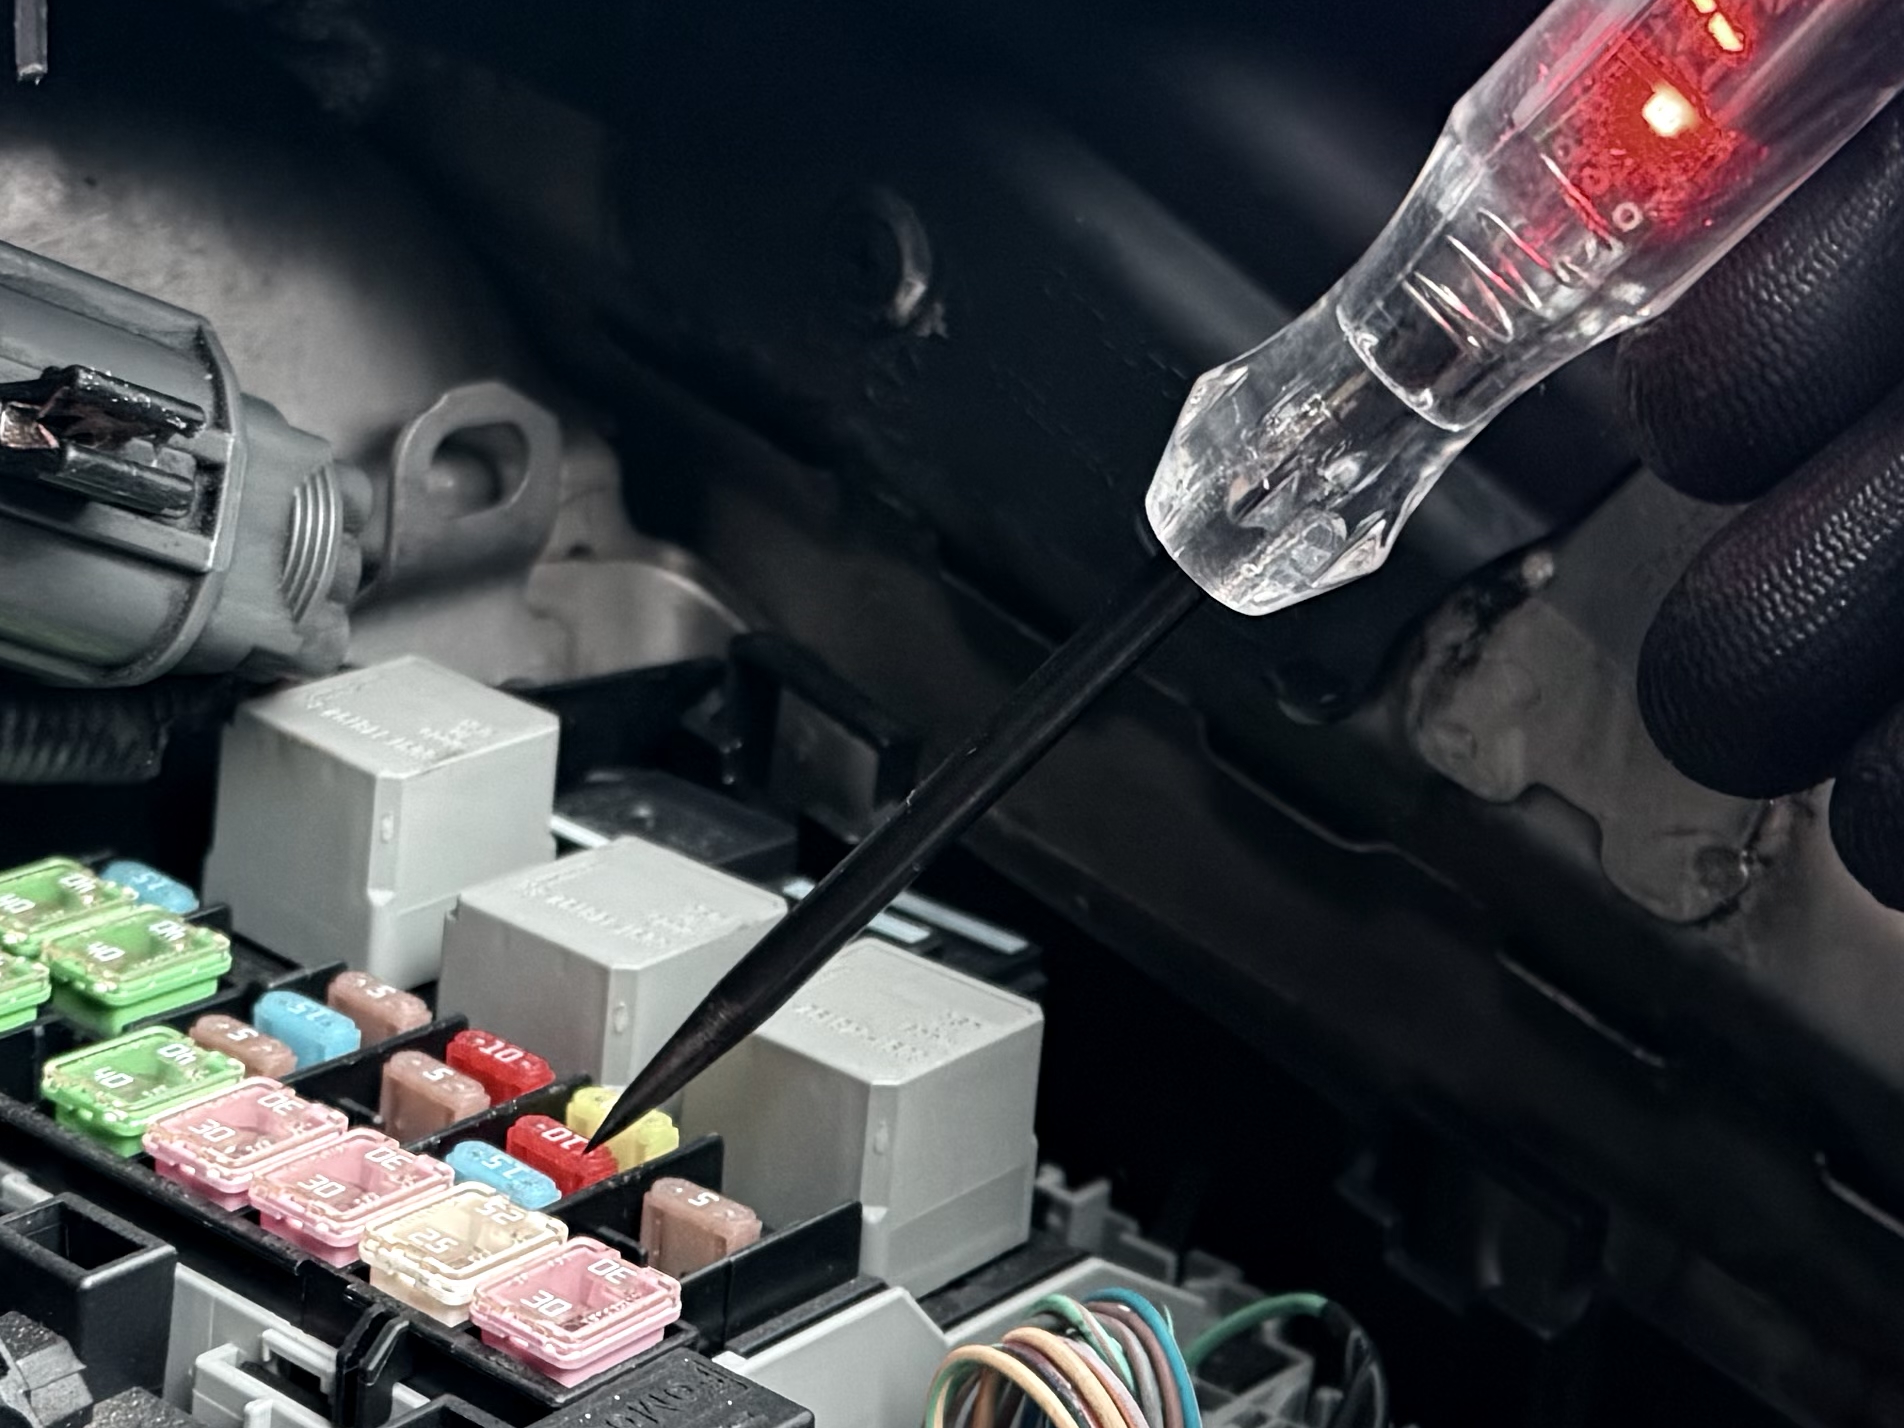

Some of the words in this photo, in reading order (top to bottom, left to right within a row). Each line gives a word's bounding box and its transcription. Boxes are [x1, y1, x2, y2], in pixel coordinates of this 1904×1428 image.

[85, 941, 125, 963] 40
[156, 1042, 198, 1065] 40
[478, 1039, 525, 1063] 10
[93, 1066, 134, 1090] 40
[422, 1066, 455, 1082] 5
[256, 1091, 306, 1116] 30
[187, 1118, 236, 1144] 30
[540, 1127, 589, 1150] 10
[364, 1146, 415, 1172] 30
[480, 1152, 527, 1180] 15
[296, 1173, 347, 1199] 30
[474, 1196, 525, 1225] 25
[688, 1190, 720, 1208] 5
[407, 1227, 460, 1255] 25
[587, 1257, 638, 1285] 30
[519, 1288, 574, 1318] 30
